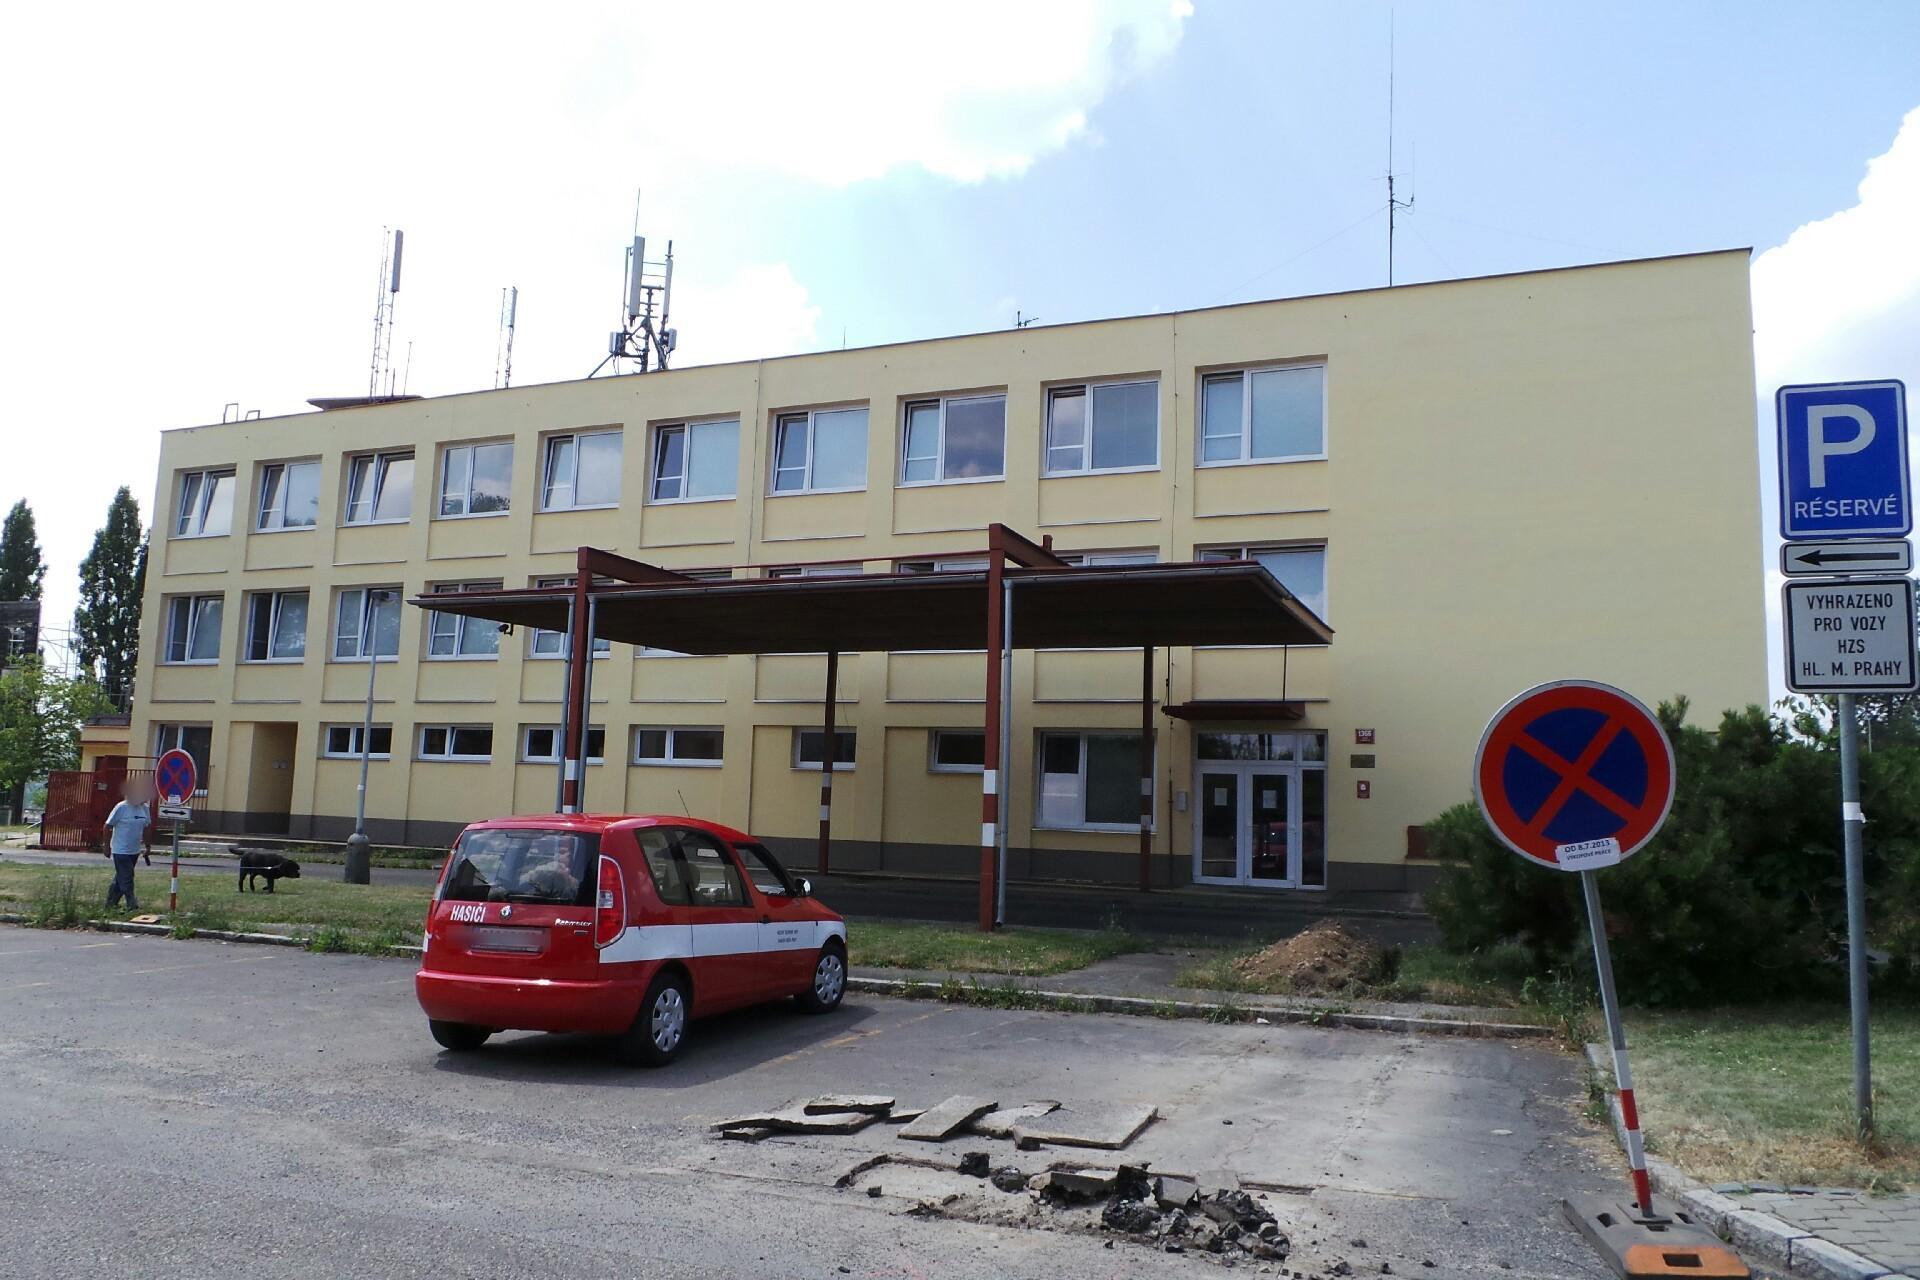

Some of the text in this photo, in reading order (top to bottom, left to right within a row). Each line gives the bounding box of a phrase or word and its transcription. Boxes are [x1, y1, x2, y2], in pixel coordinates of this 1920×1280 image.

[1807, 404, 1876, 488] P
[1795, 494, 1898, 519] RÉSERVÉ
[1806, 593, 1893, 610] VYHRAZENO
[1814, 616, 1886, 632] PRO VOZY
[1838, 639, 1865, 654] HZS
[1802, 661, 1902, 677] HL. M. PRAHY
[1564, 845, 1577, 853] OD
[450, 902, 486, 922] HASIČI
